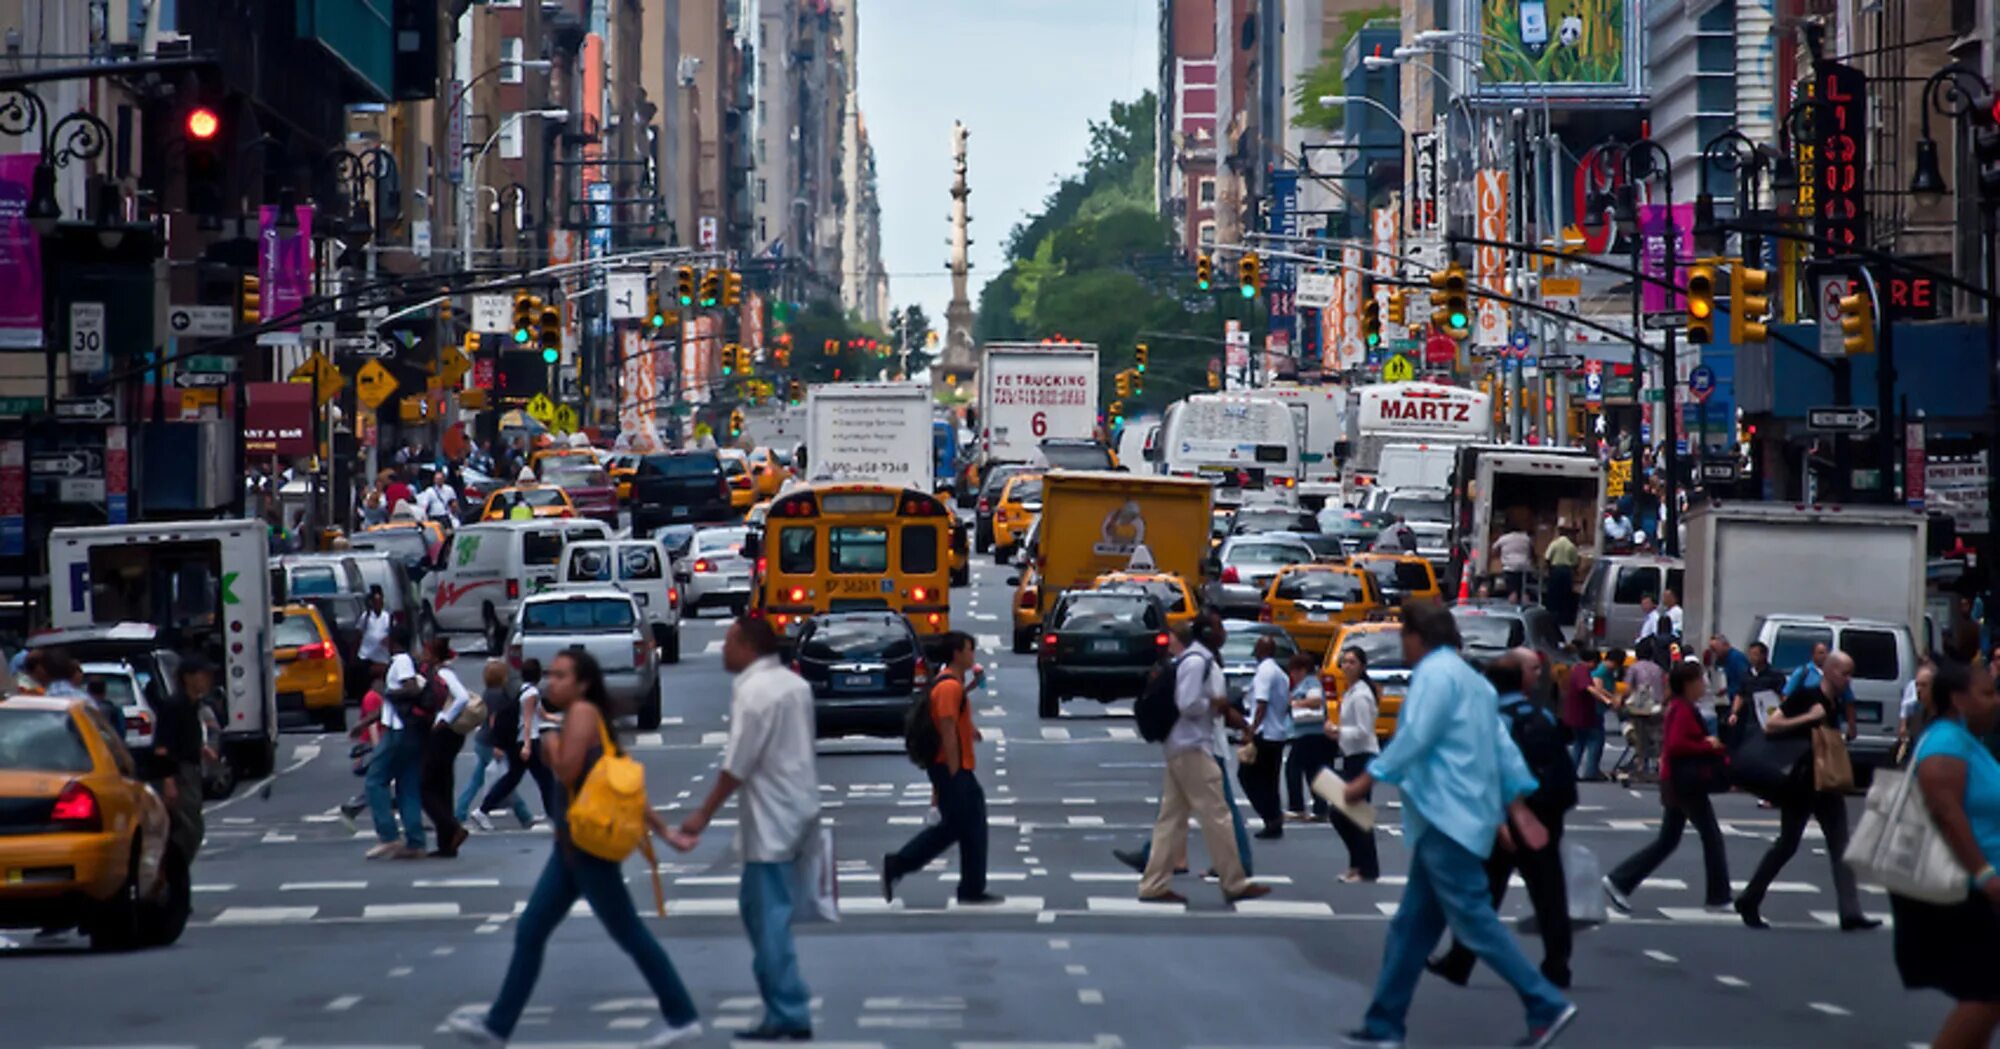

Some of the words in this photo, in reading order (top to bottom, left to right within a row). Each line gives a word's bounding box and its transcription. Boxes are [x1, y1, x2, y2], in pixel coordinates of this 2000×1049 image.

[74, 331, 100, 351] 30
[1017, 374, 1086, 387] TRUCKING
[1380, 400, 1469, 421] MARTZ
[1032, 411, 1047, 437] 6
